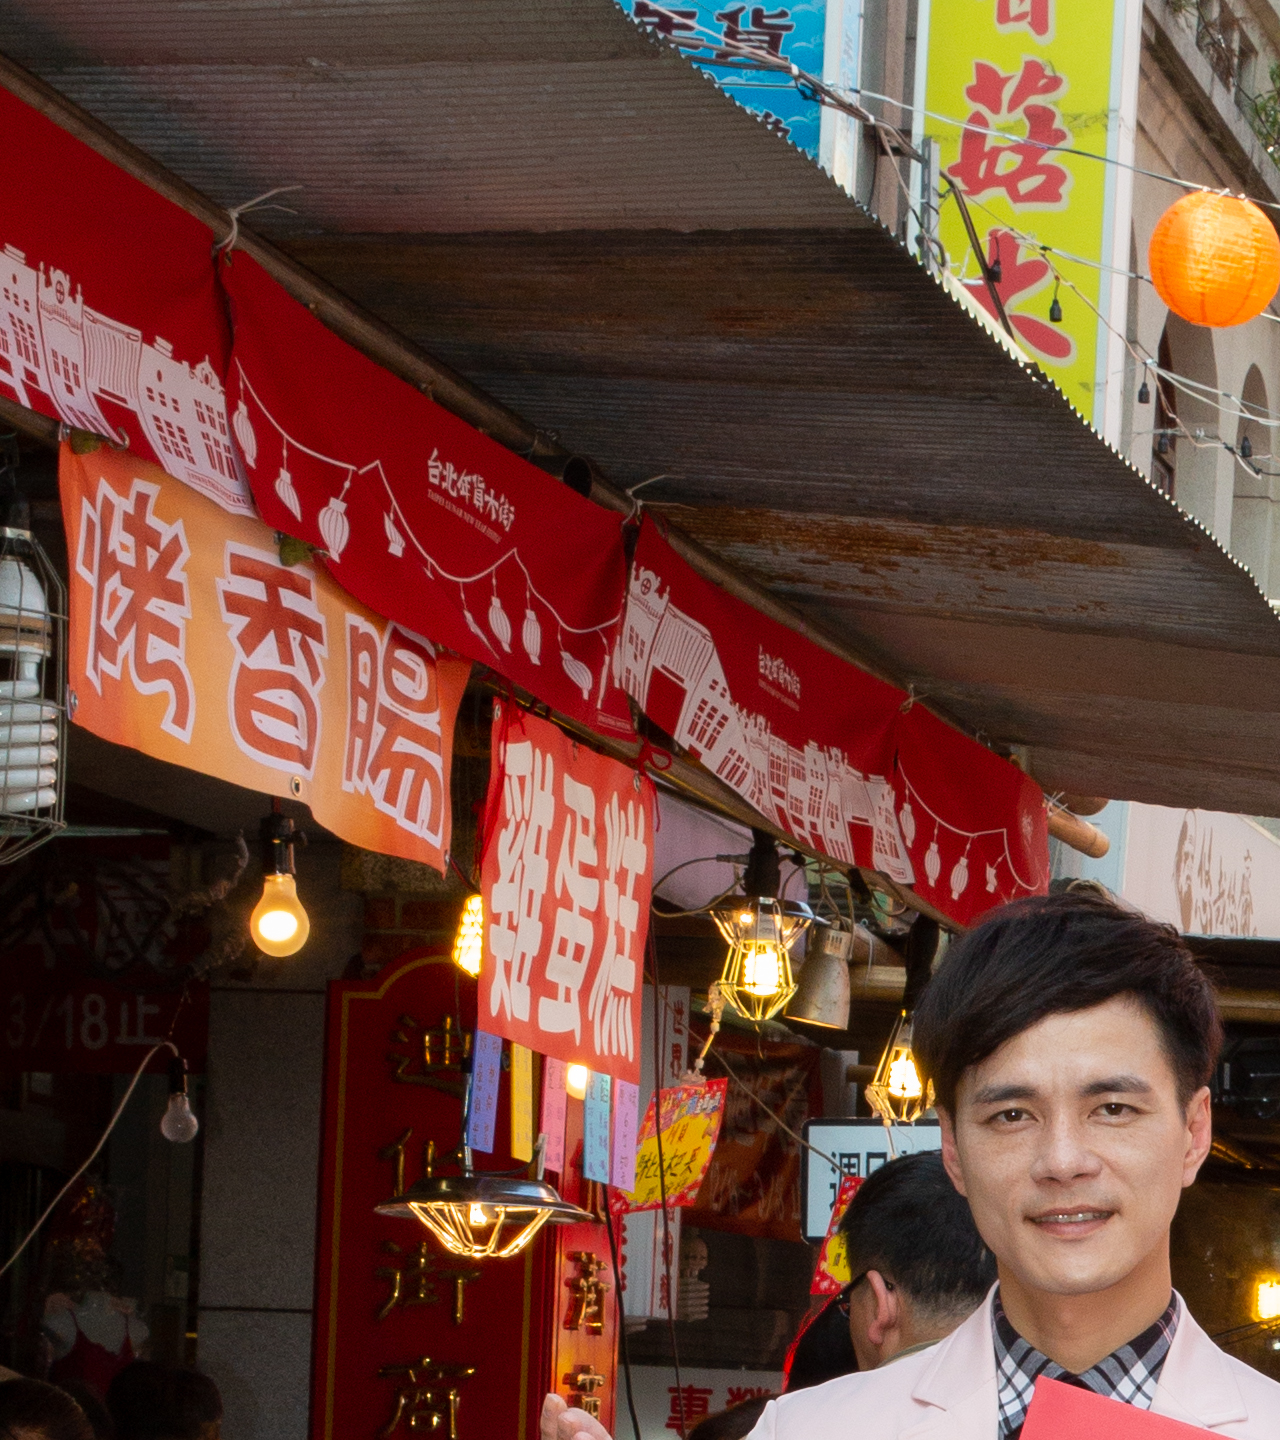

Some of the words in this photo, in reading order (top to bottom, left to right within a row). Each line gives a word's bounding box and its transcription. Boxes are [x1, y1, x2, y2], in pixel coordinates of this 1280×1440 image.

[427, 447, 515, 532] 台北年貨大街
[75, 475, 444, 848] 烤香腸
[489, 741, 648, 1062] 雞蛋糕
